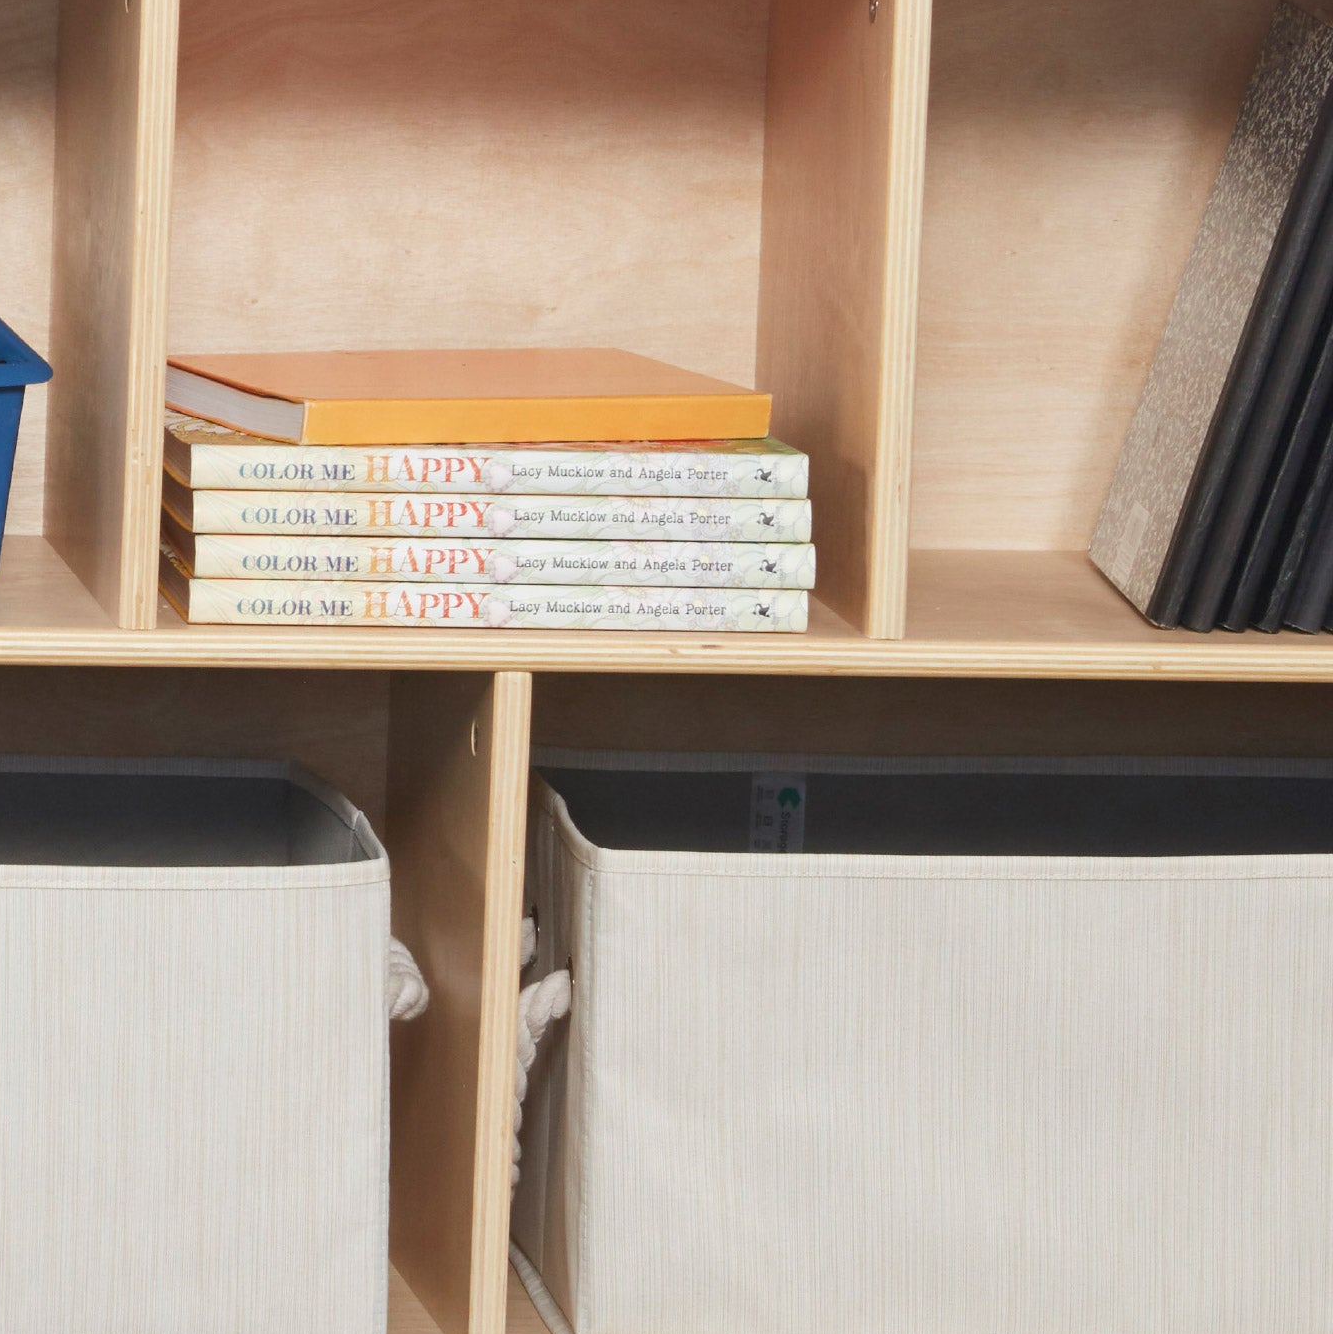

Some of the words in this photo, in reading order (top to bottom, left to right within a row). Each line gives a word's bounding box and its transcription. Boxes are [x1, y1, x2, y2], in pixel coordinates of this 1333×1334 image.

[239, 462, 313, 480] COLOR
[321, 463, 355, 481] ME
[364, 455, 492, 483] HAPPY
[511, 464, 542, 479] Lacy
[548, 465, 604, 479] Mucklow
[611, 467, 632, 479] and
[638, 468, 681, 482] Angela
[688, 469, 729, 481] Porter
[241, 506, 316, 525] COLOR
[324, 508, 357, 526] ME
[367, 499, 495, 528] HAPPY
[513, 509, 544, 523] Lacy
[550, 510, 606, 523] Mucklow
[612, 512, 635, 524] and
[641, 512, 684, 526] Angela
[690, 513, 731, 525] Porter
[242, 554, 317, 572] COLOR
[326, 555, 358, 572] ME
[369, 546, 496, 575] HAPPY
[515, 556, 546, 570] Lacy
[552, 557, 608, 570] Mucklow
[614, 559, 637, 571] and
[643, 559, 686, 573] Angela
[692, 560, 733, 572] Porter
[237, 598, 311, 616] COLOR
[319, 599, 353, 616] ME
[363, 590, 491, 618] HAPPY
[509, 600, 540, 615] Lacy
[545, 601, 602, 614] Mucklow
[608, 603, 630, 615] and
[636, 603, 679, 617] Angela
[685, 604, 726, 616] Porter
